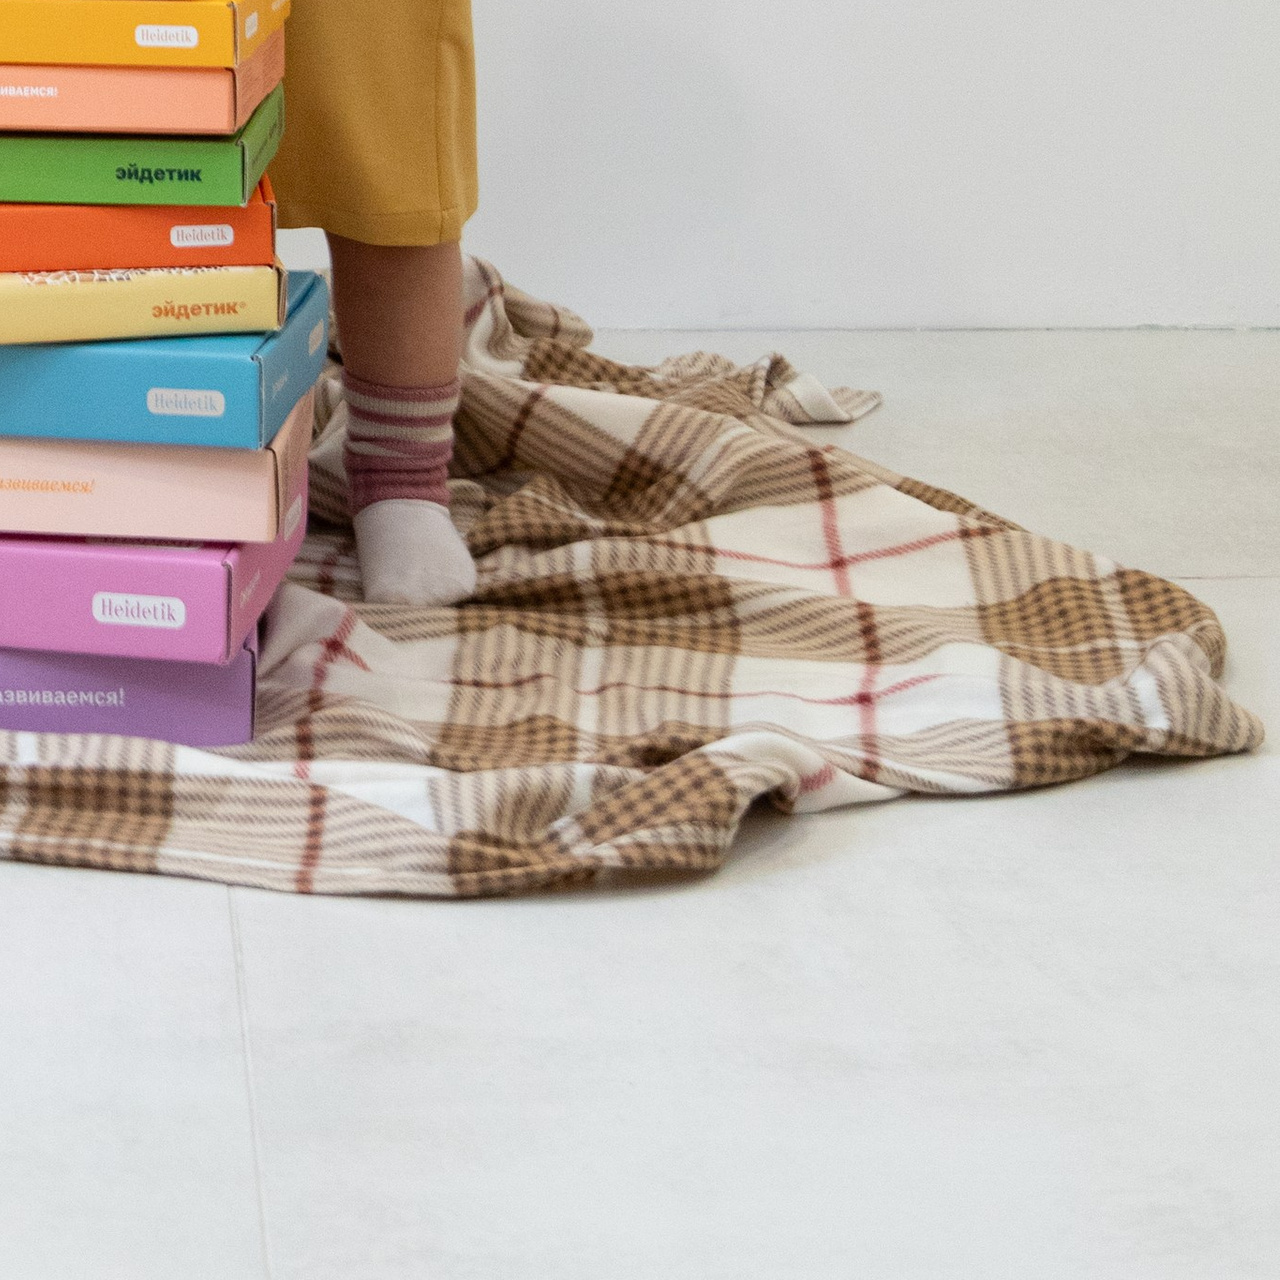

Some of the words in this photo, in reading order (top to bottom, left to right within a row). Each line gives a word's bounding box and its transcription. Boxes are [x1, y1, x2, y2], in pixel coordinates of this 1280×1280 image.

[140, 28, 193, 45] Heidetik
[115, 163, 202, 186] эйдетик
[176, 227, 229, 244] Heidetik
[153, 392, 219, 413] Heidetik
[100, 597, 177, 623] Heidetik
